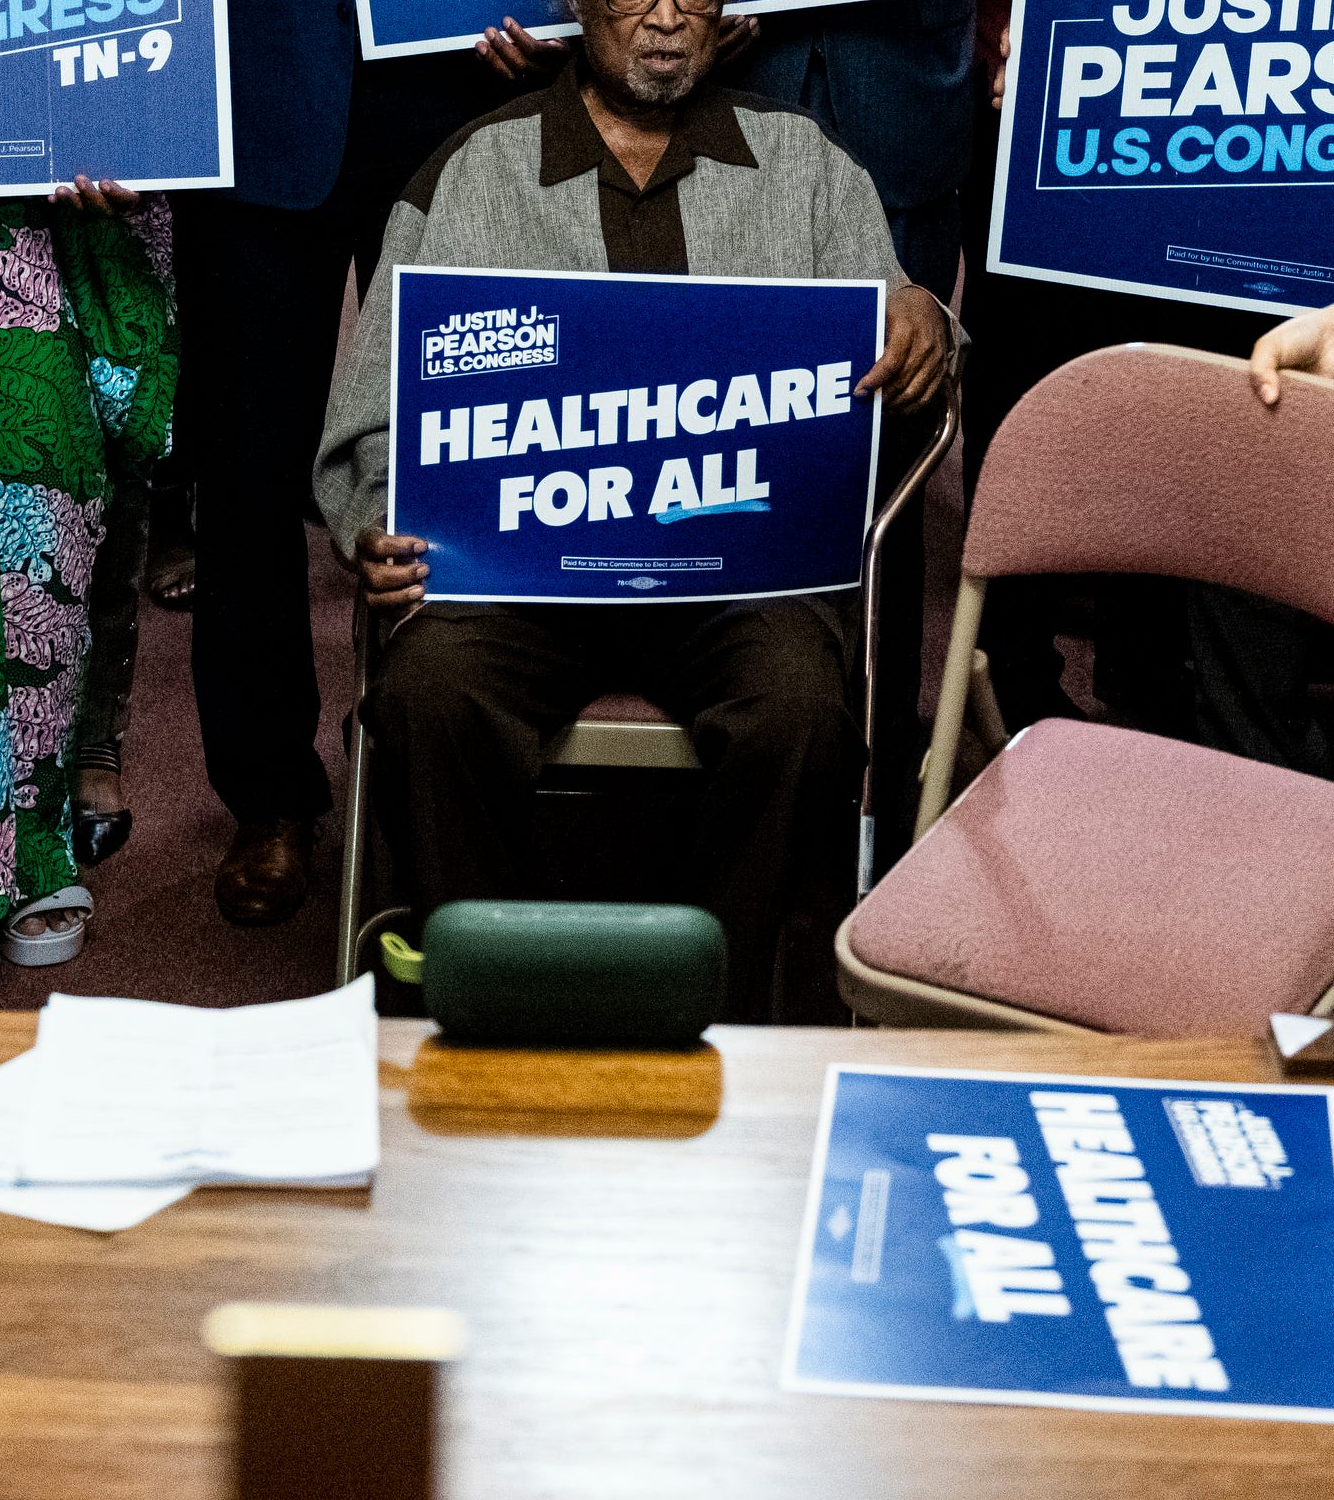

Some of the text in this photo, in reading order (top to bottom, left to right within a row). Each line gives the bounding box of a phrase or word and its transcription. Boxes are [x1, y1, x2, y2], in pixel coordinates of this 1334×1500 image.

[53, 29, 173, 87] TN-9
[9, 144, 41, 152] Pearson
[1169, 250, 1186, 258] Paid
[1227, 258, 1269, 270] Committee
[1281, 266, 1300, 274] Elect
[1301, 268, 1324, 277] Justin
[426, 324, 554, 358] PEARSON
[439, 308, 517, 333] JUSTIN
[421, 361, 851, 466] HEALTHCARE
[499, 448, 770, 531] FOR ALL
[927, 1134, 1071, 1323] FOR ALL
[1029, 1090, 1231, 1392] HEALTHCARE
